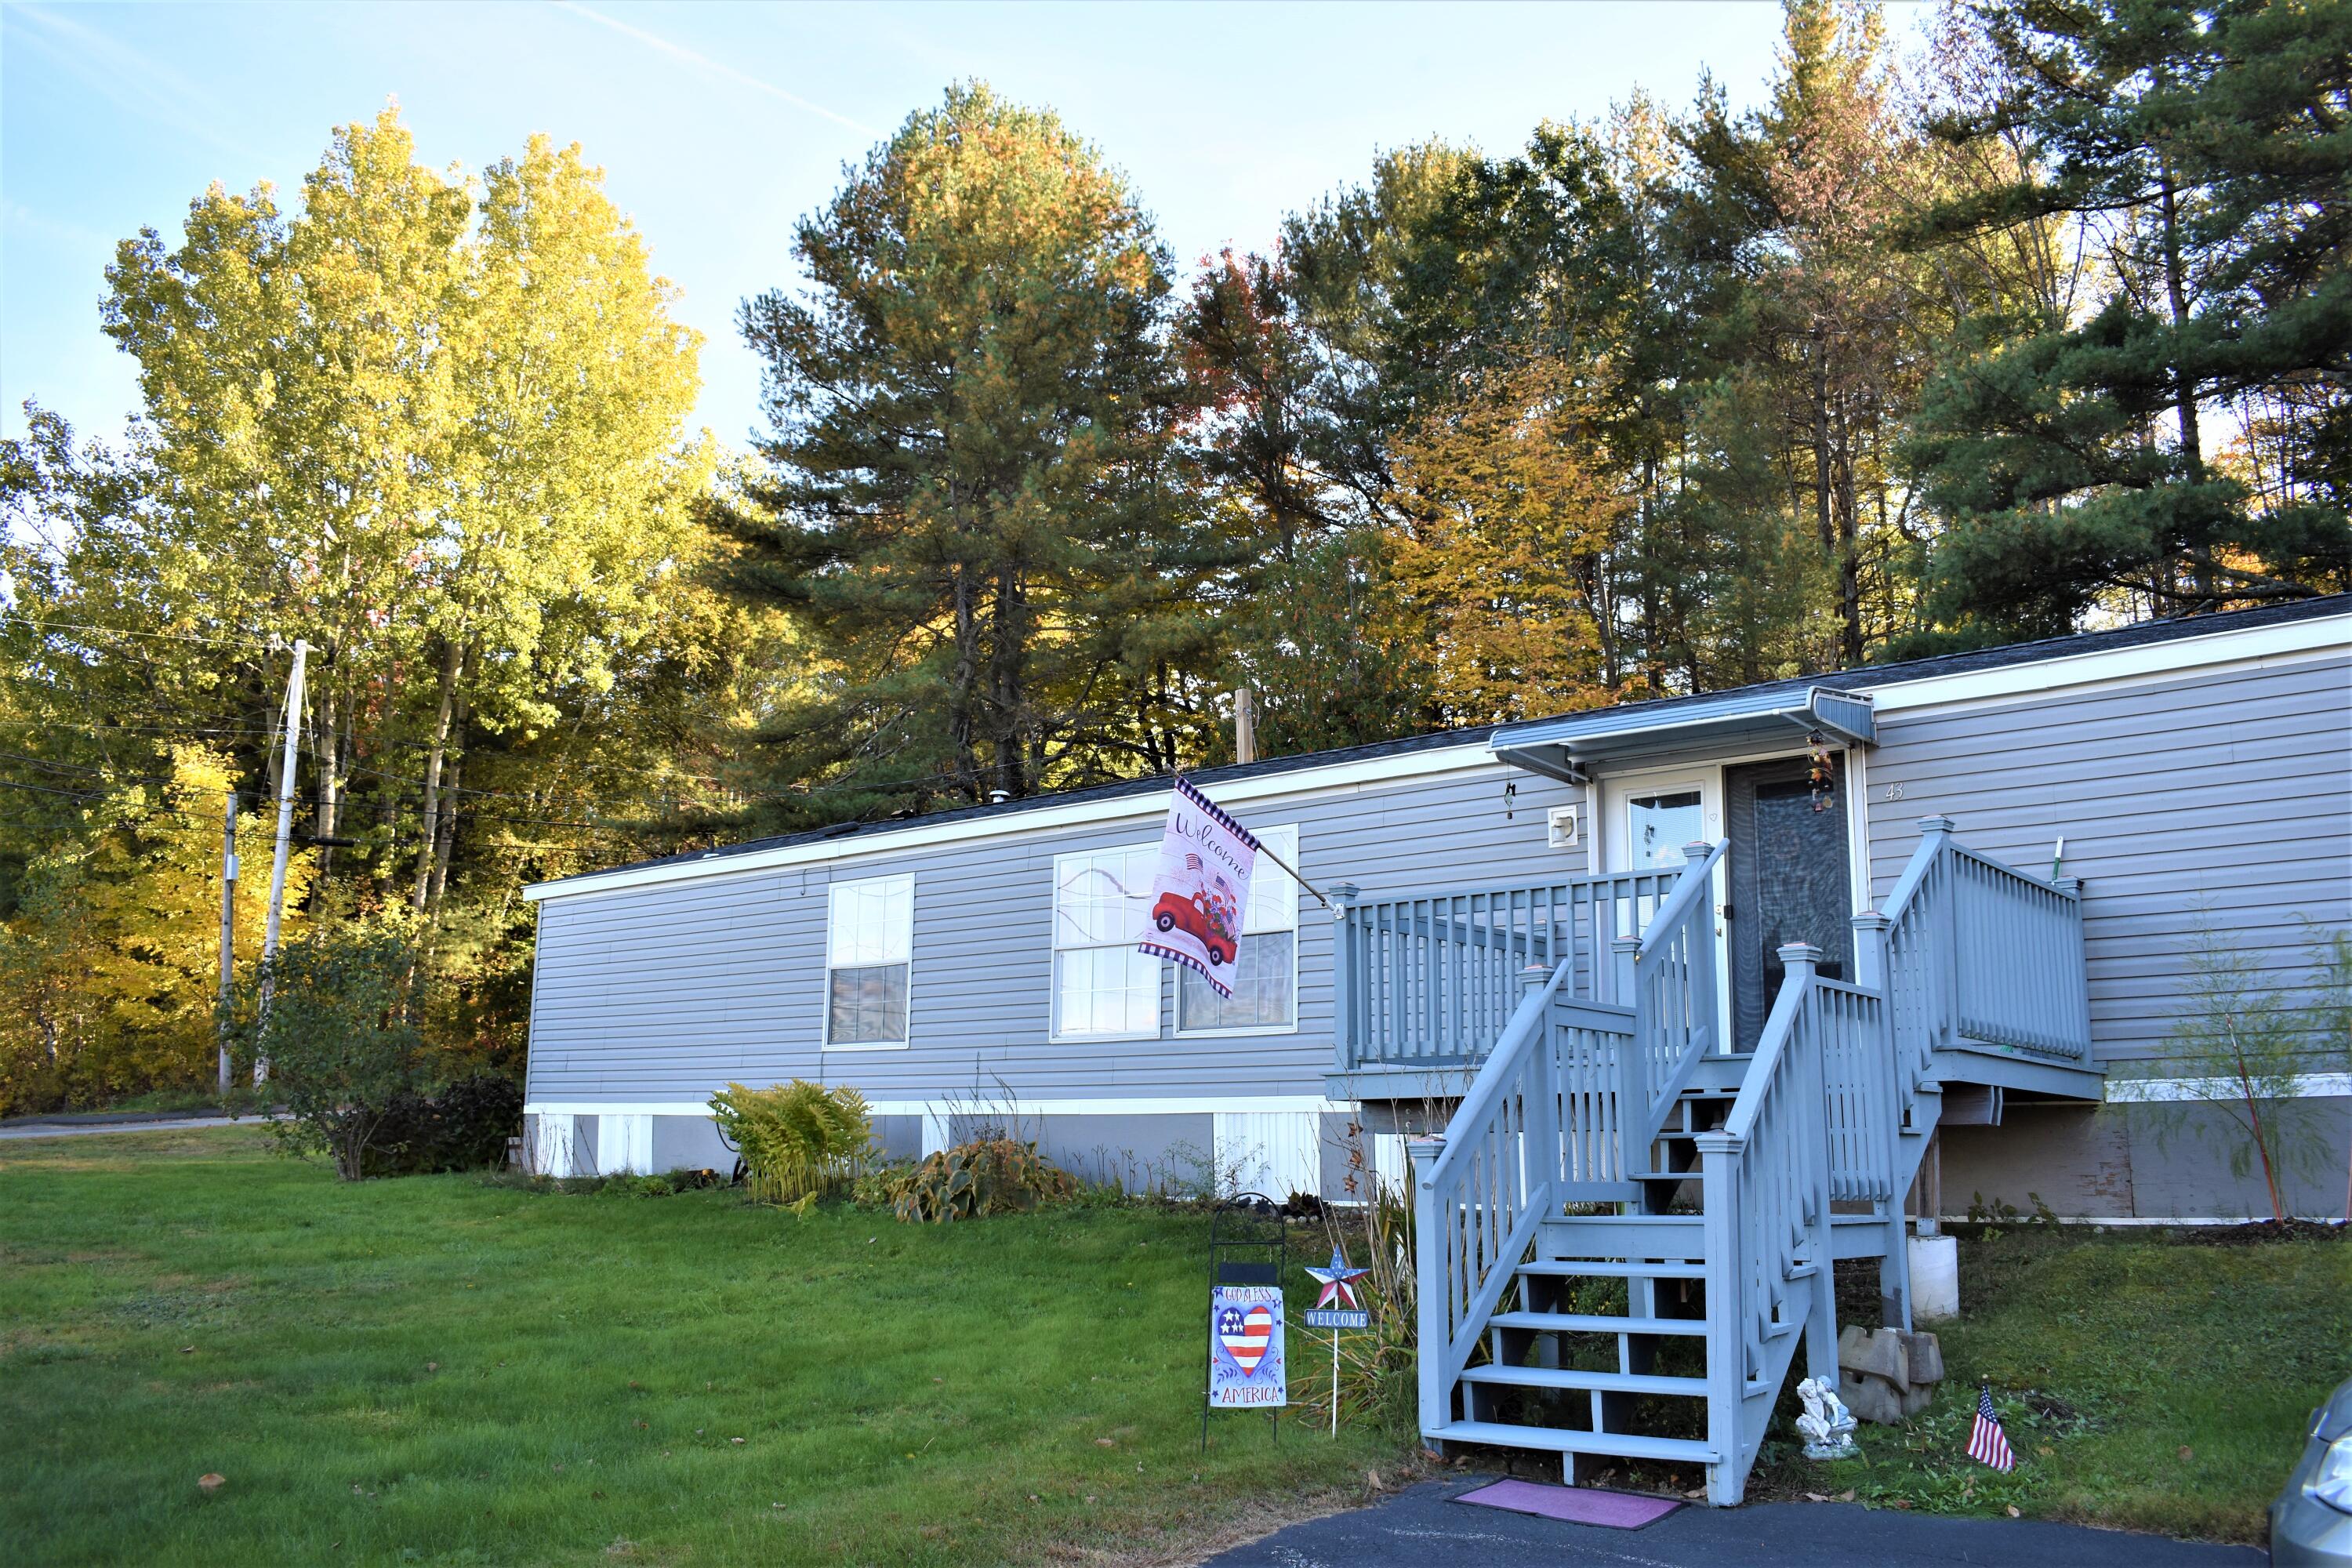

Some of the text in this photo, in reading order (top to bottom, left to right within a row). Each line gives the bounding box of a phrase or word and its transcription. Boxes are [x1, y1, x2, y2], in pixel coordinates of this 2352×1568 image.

[1886, 782, 1904, 801] 43
[1176, 812, 1248, 880] Welcome
[1226, 1287, 1272, 1301] GOD BLESS
[1306, 1312, 1367, 1327] WELCOME
[1222, 1387, 1279, 1403] AMERICA
